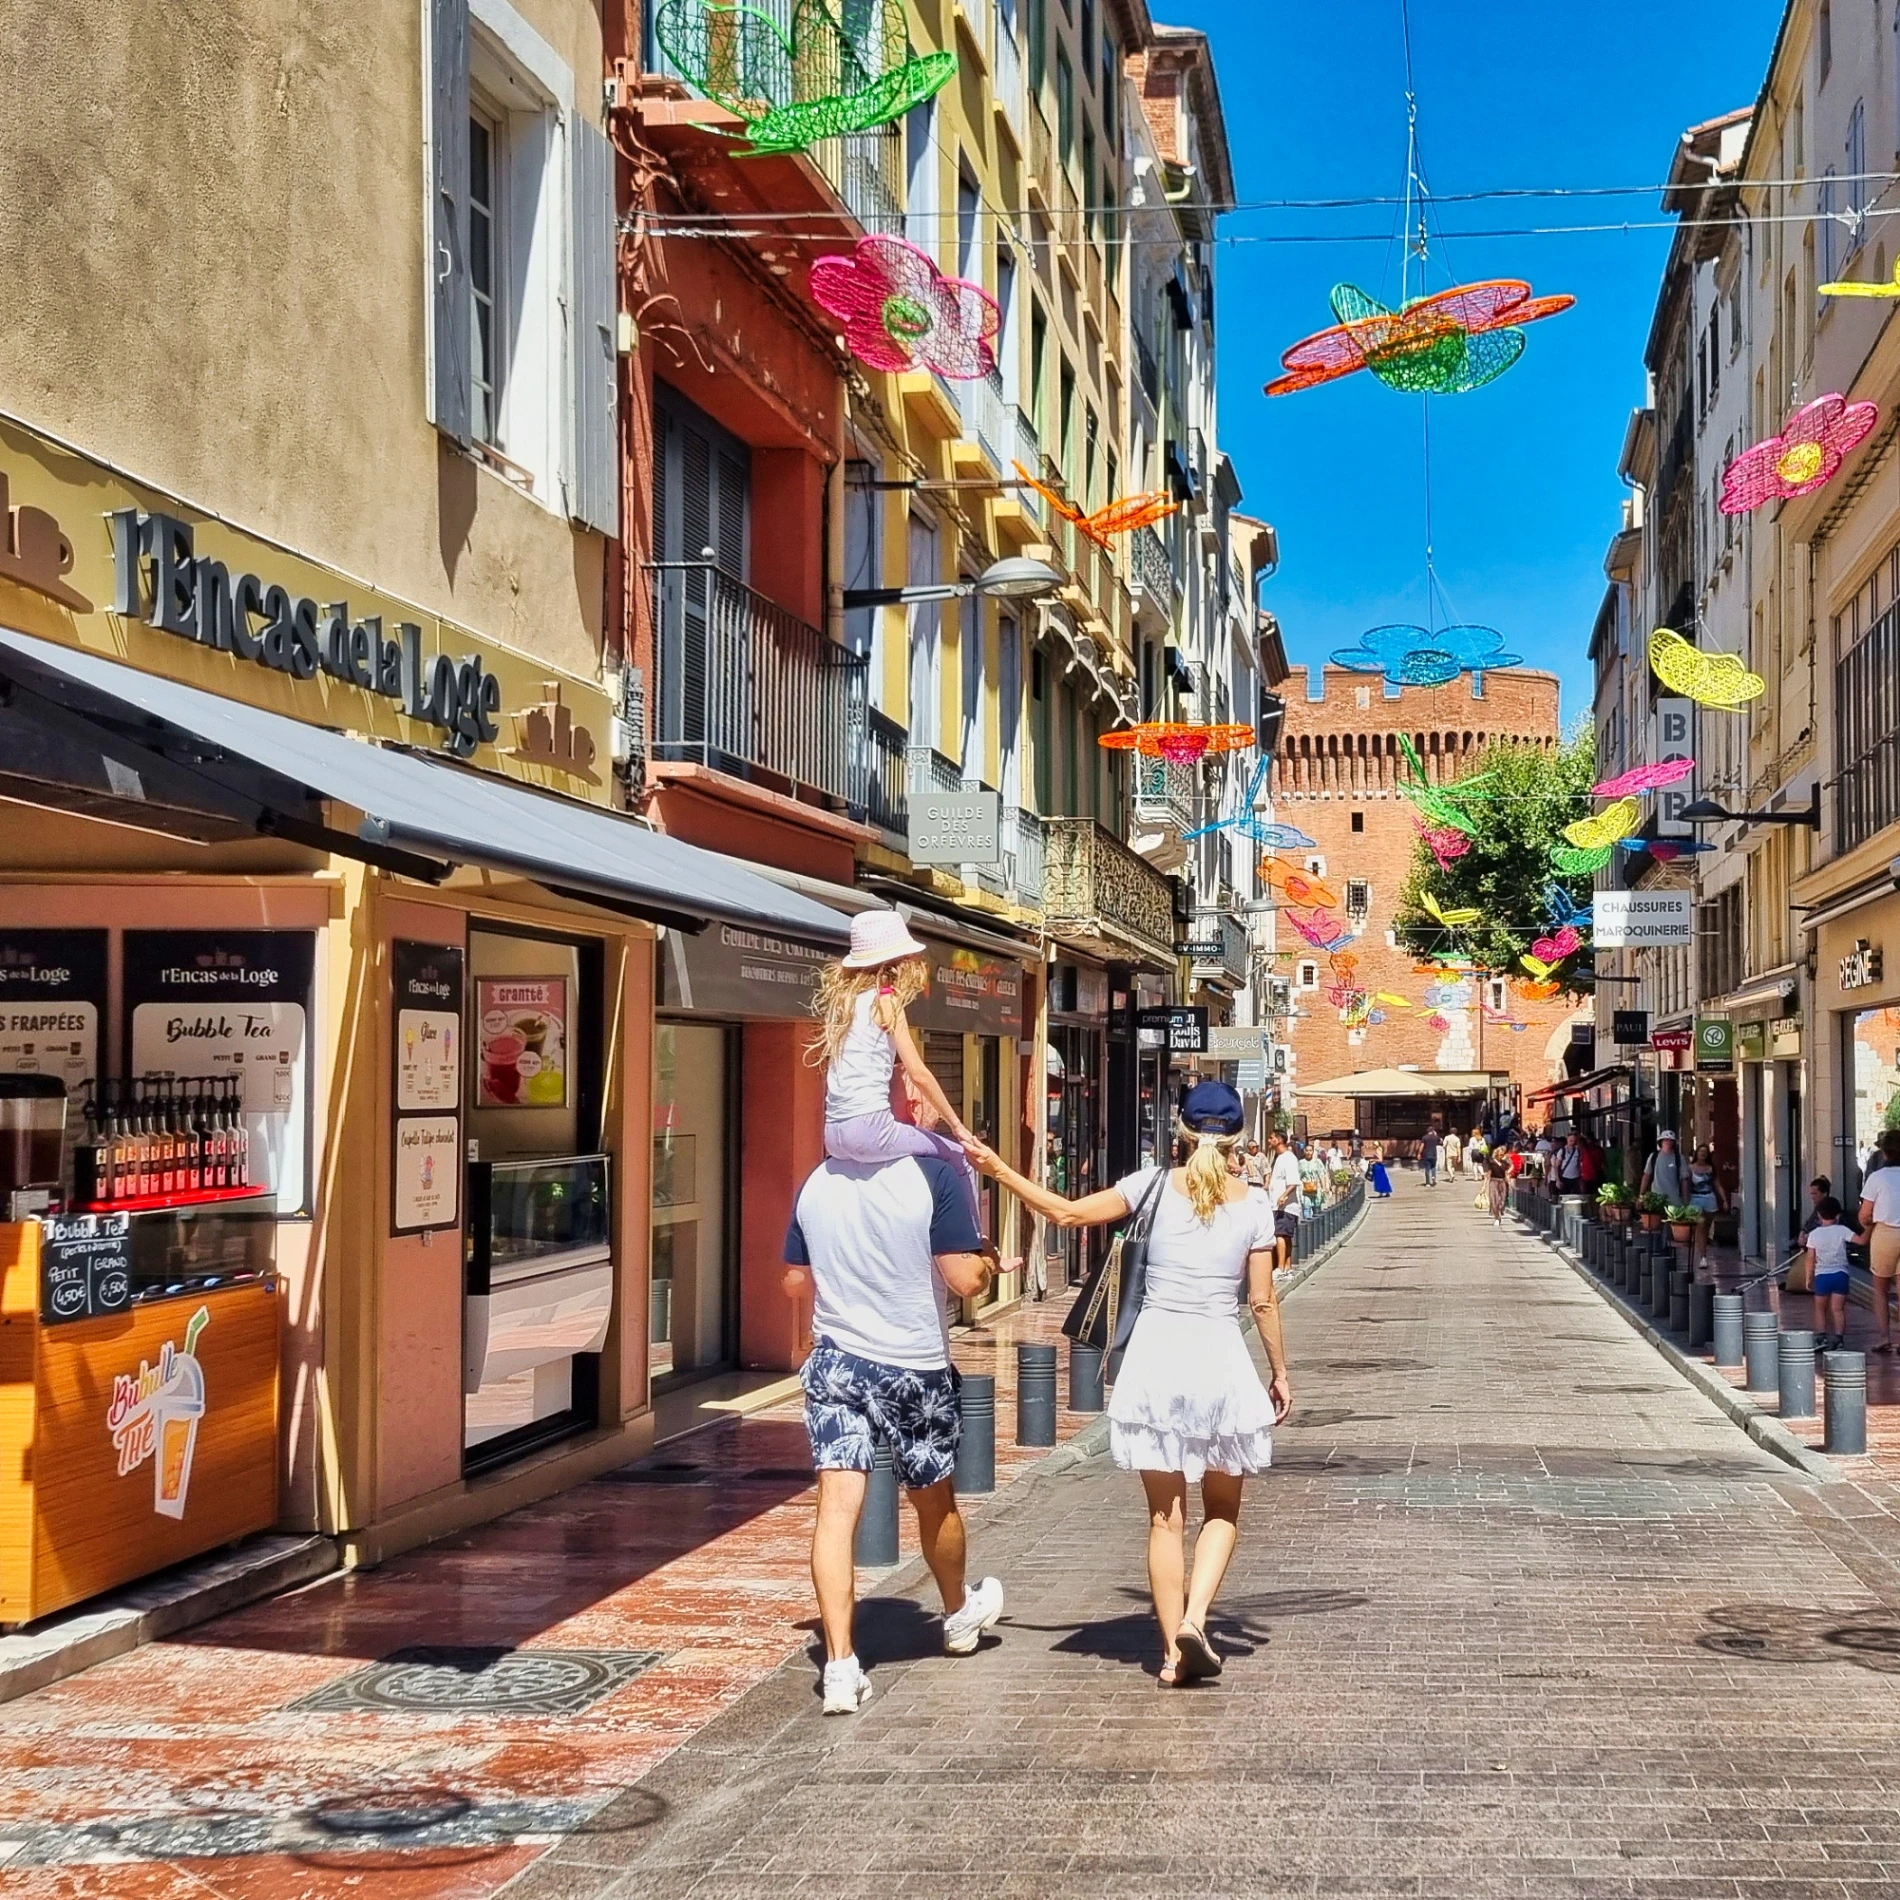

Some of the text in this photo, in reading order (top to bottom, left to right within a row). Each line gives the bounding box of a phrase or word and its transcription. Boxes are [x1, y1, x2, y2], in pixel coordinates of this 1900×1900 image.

[321, 600, 372, 689] de
[365, 614, 402, 698] la
[401, 622, 500, 758] Loge
[927, 806, 984, 820] GUILDE
[941, 820, 970, 833] DES
[917, 833, 994, 849] ORFÈVRES
[1602, 901, 1683, 913] CHAUSSURES
[1595, 924, 1690, 937] MAROQUINERIE
[30, 966, 70, 986] Loge
[219, 972, 230, 981] de
[231, 973, 239, 981] la
[239, 968, 279, 988] Loge
[11, 1012, 86, 1031] FRAPPÉES
[166, 1014, 274, 1043] Bubble Tea
[1616, 1022, 1645, 1032] PAUL
[1169, 1036, 1201, 1049] David
[94, 1256, 128, 1271] GRAND
